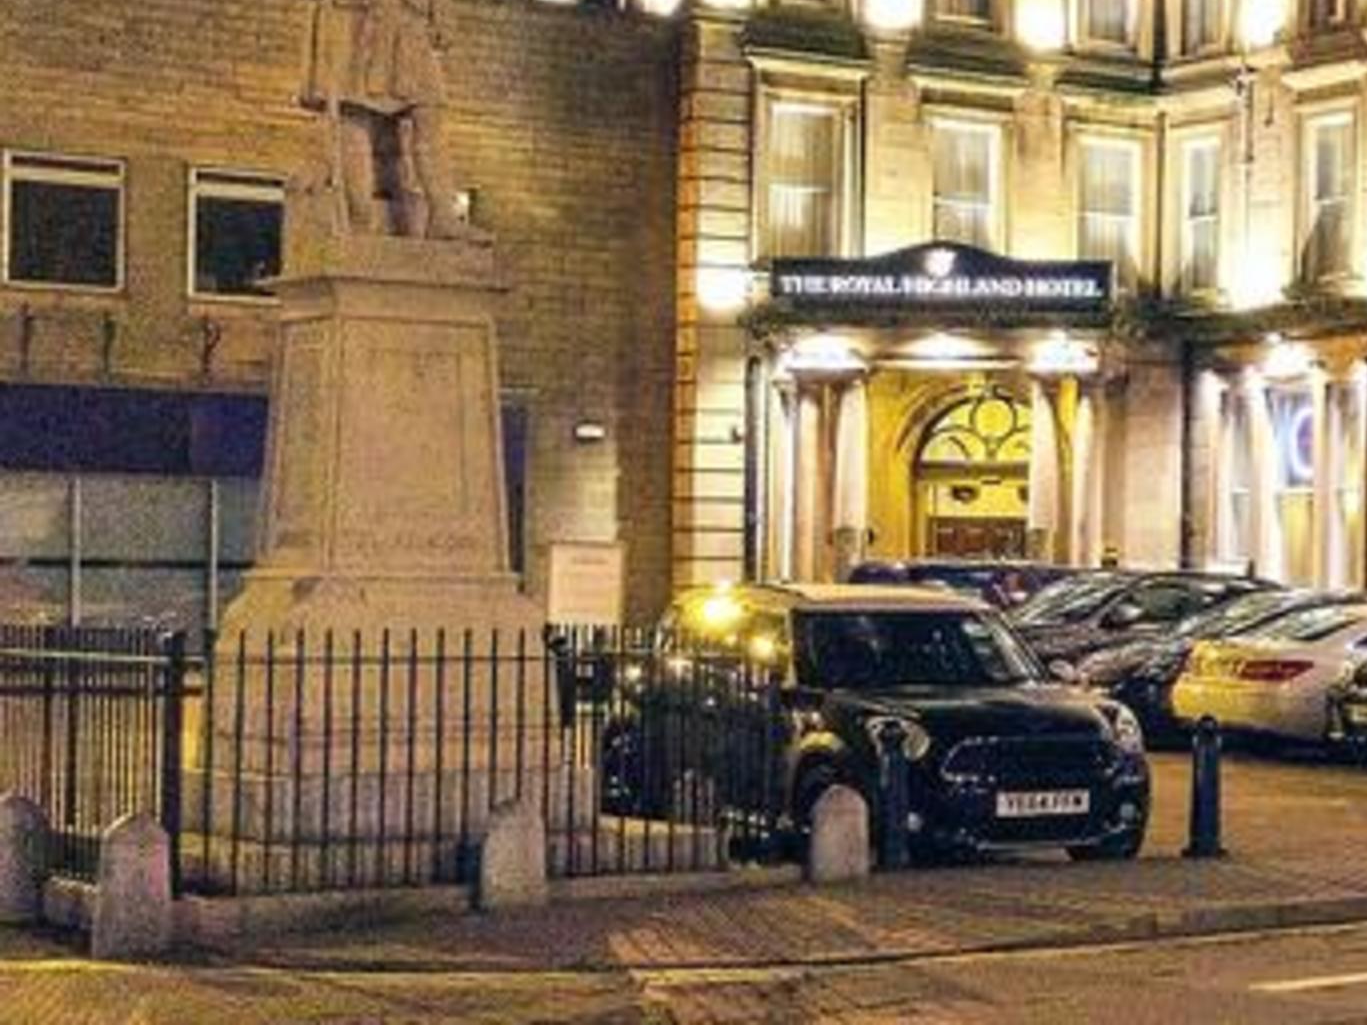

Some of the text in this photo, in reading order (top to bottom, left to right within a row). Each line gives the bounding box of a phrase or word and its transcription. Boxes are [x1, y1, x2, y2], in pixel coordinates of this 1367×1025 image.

[779, 275, 1104, 297] THE ROYAL HIGHLAND HOTEL
